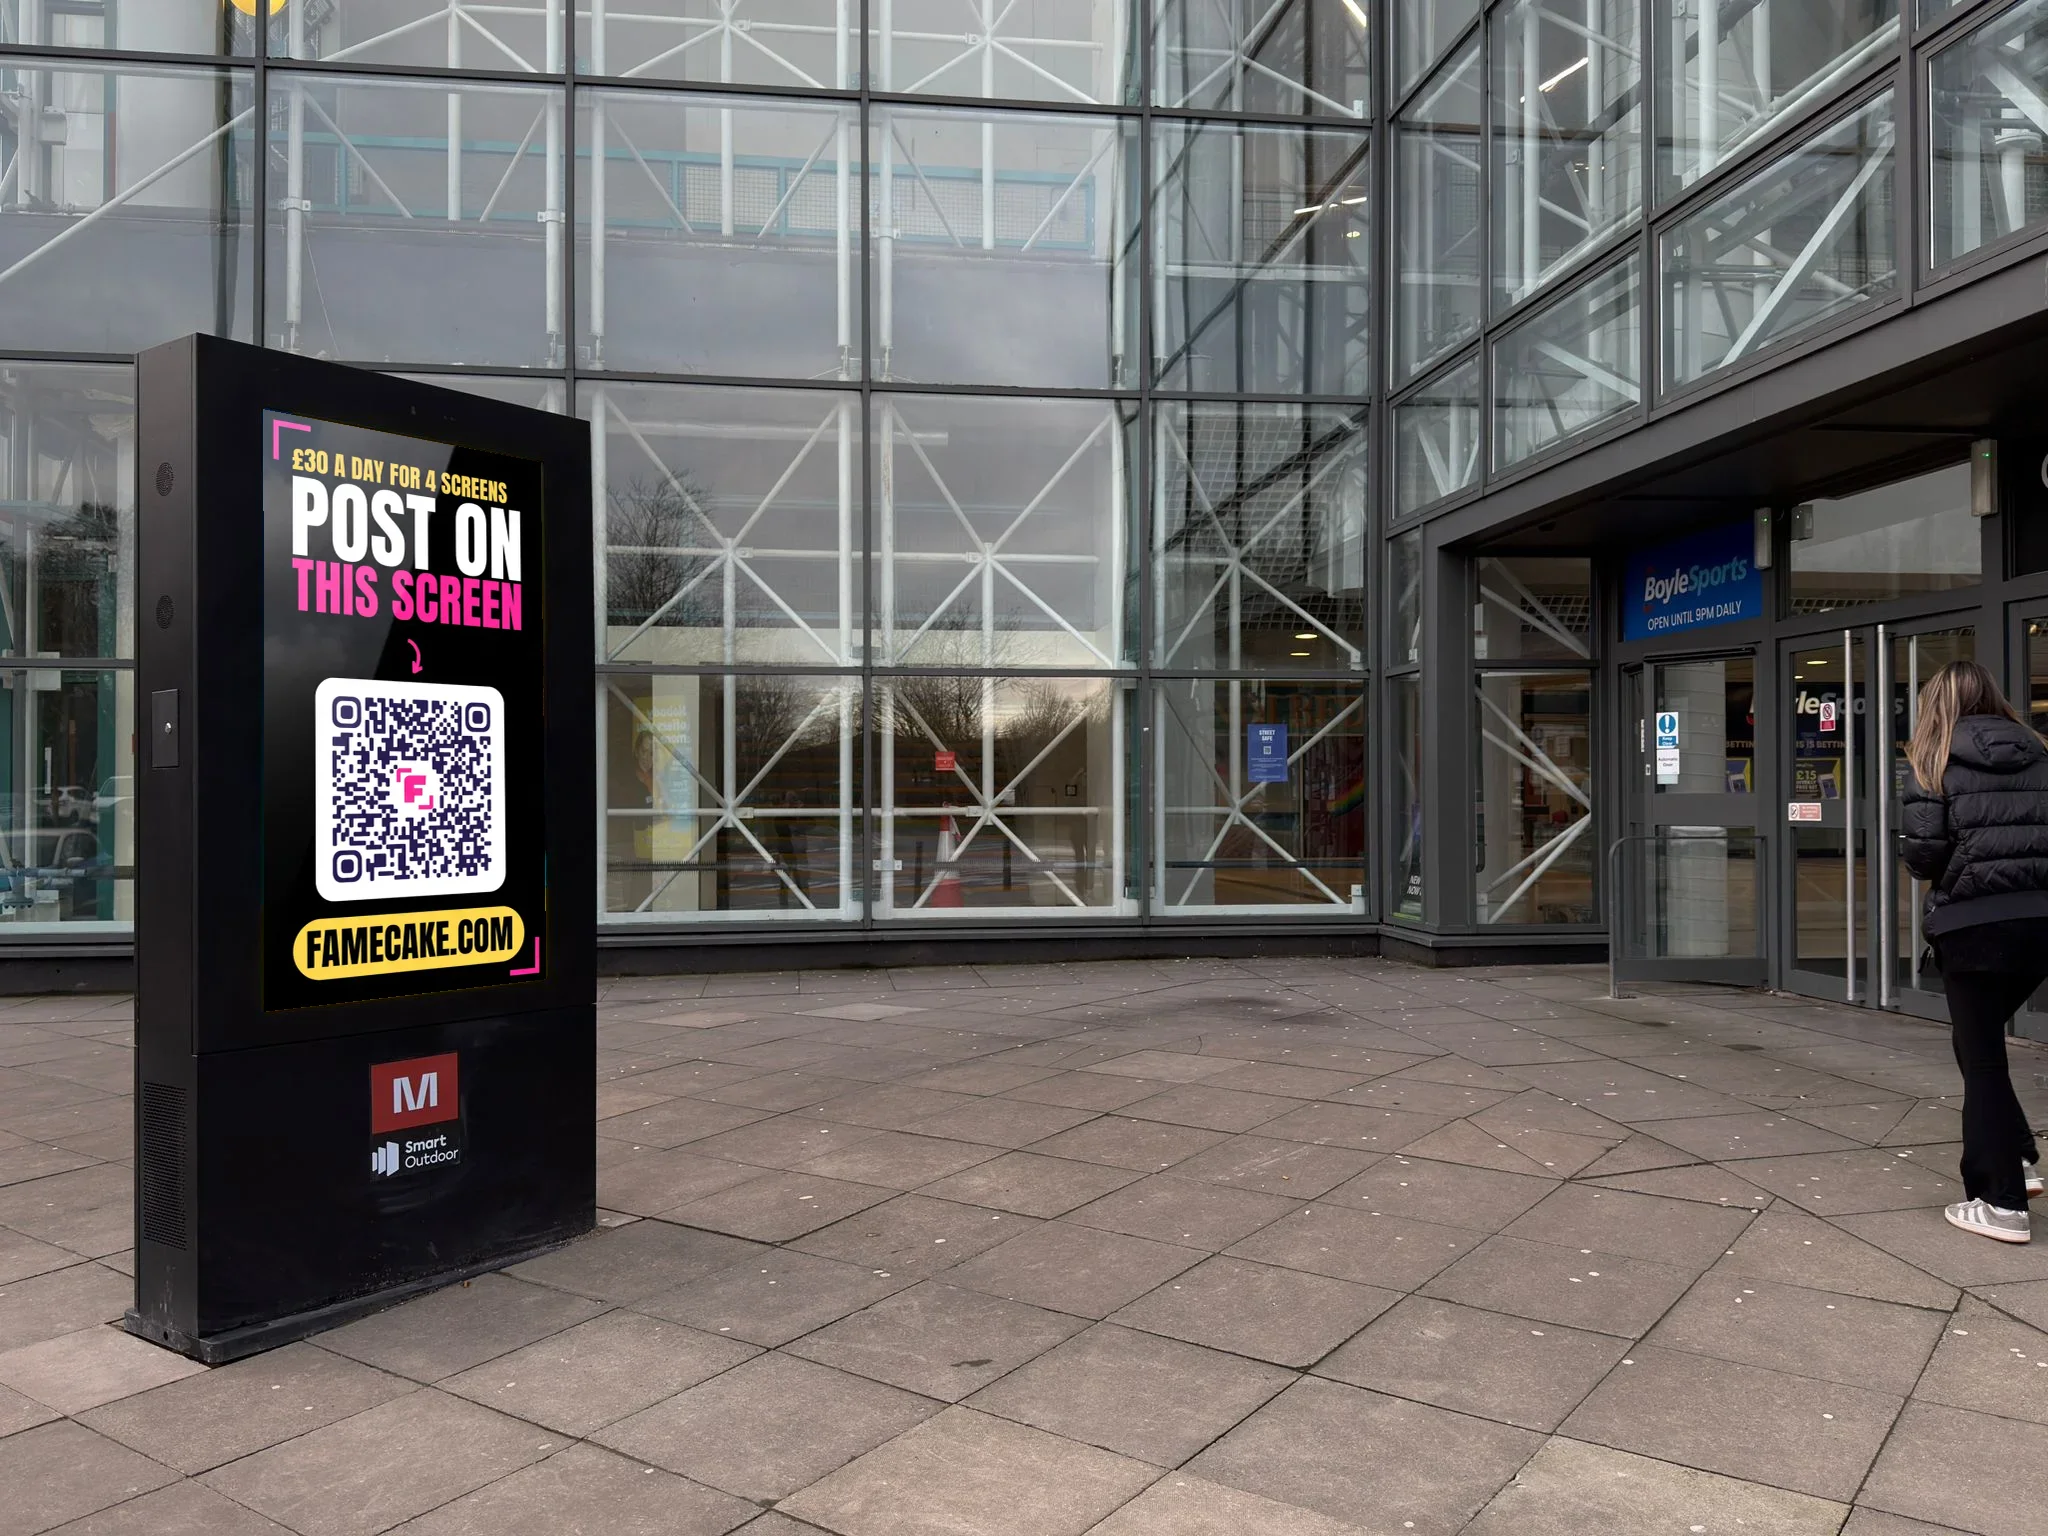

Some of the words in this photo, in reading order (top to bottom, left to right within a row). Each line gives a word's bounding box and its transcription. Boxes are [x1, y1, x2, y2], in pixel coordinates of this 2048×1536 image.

[292, 448, 328, 474] £30
[334, 453, 346, 478] A
[351, 456, 384, 484] DAY
[390, 463, 420, 490] FOR
[425, 470, 436, 492] 4
[441, 472, 508, 504] SCREENS
[292, 475, 436, 570] POST
[455, 502, 522, 582] ON
[292, 557, 379, 618] THIS
[392, 569, 522, 631] SCREEN
[1644, 556, 1748, 604] BoyleSports
[1648, 616, 1669, 631] OPEN
[1671, 611, 1694, 627] UNTIL
[1695, 606, 1715, 622] 9PM
[1716, 600, 1742, 618] DAILY
[306, 916, 513, 969] FAMECAKE.COM
[393, 1072, 438, 1114] M
[405, 1134, 447, 1154] Smart
[405, 1149, 459, 1169] Outdoor
